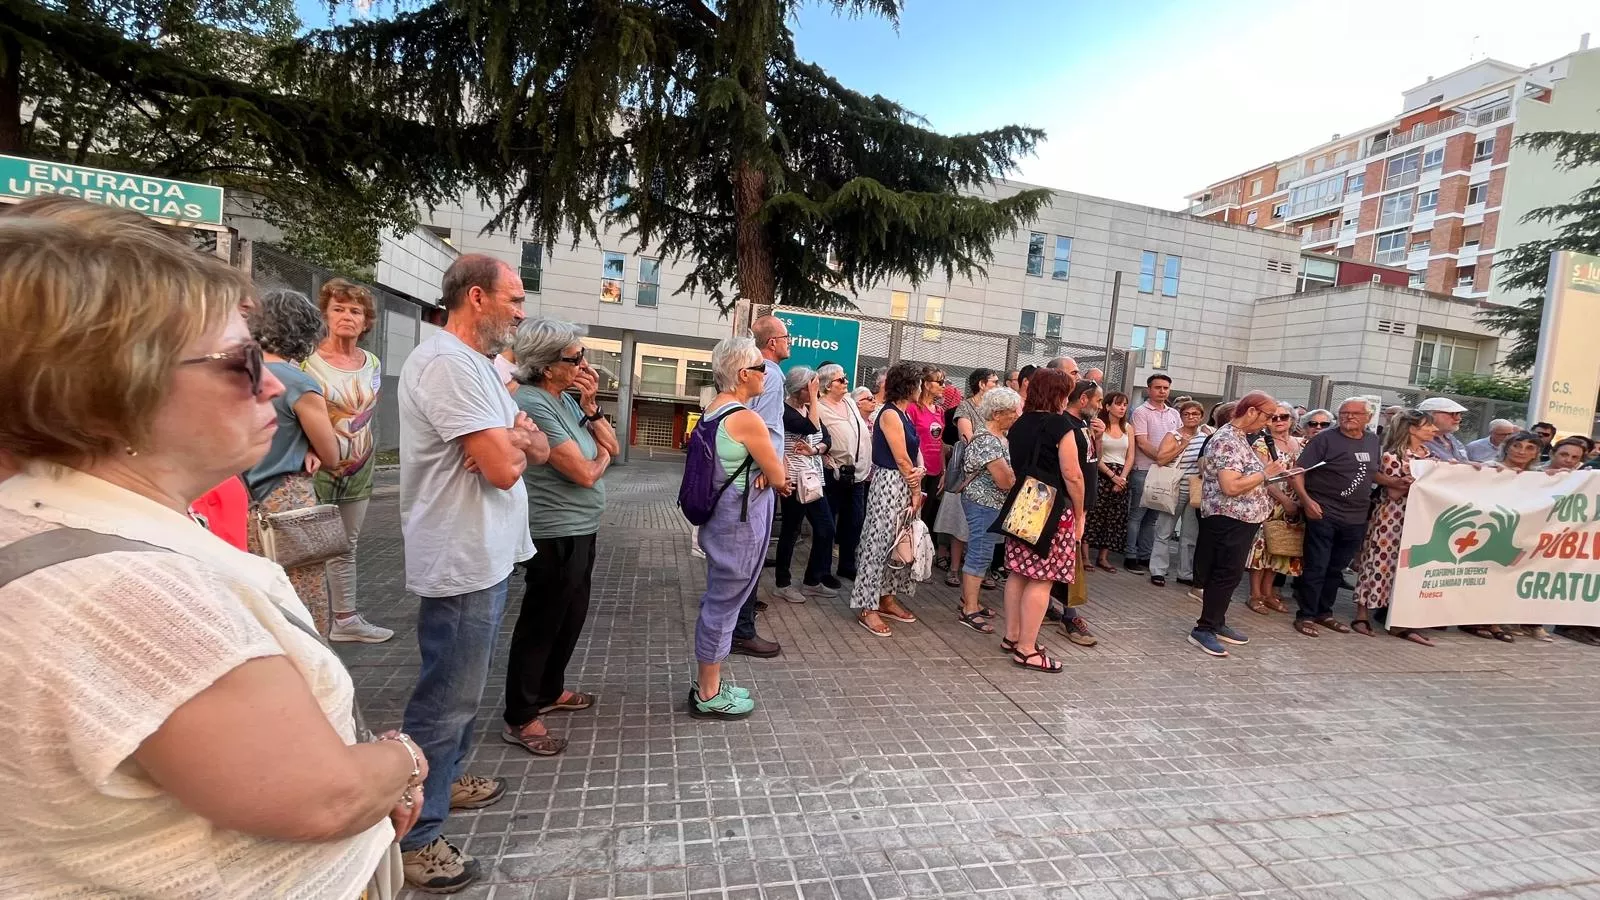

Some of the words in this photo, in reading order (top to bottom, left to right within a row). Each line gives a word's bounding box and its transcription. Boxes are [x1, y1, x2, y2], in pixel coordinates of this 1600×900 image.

[29, 163, 185, 200] ENTRADA
[9, 178, 203, 219] URGENCIAS
[788, 333, 839, 351] irineos
[1552, 381, 1572, 394] C.S.
[1545, 493, 1588, 523] POR
[1421, 580, 1431, 589] DE
[1431, 579, 1439, 589] LA
[1516, 570, 1600, 603] GRATU
